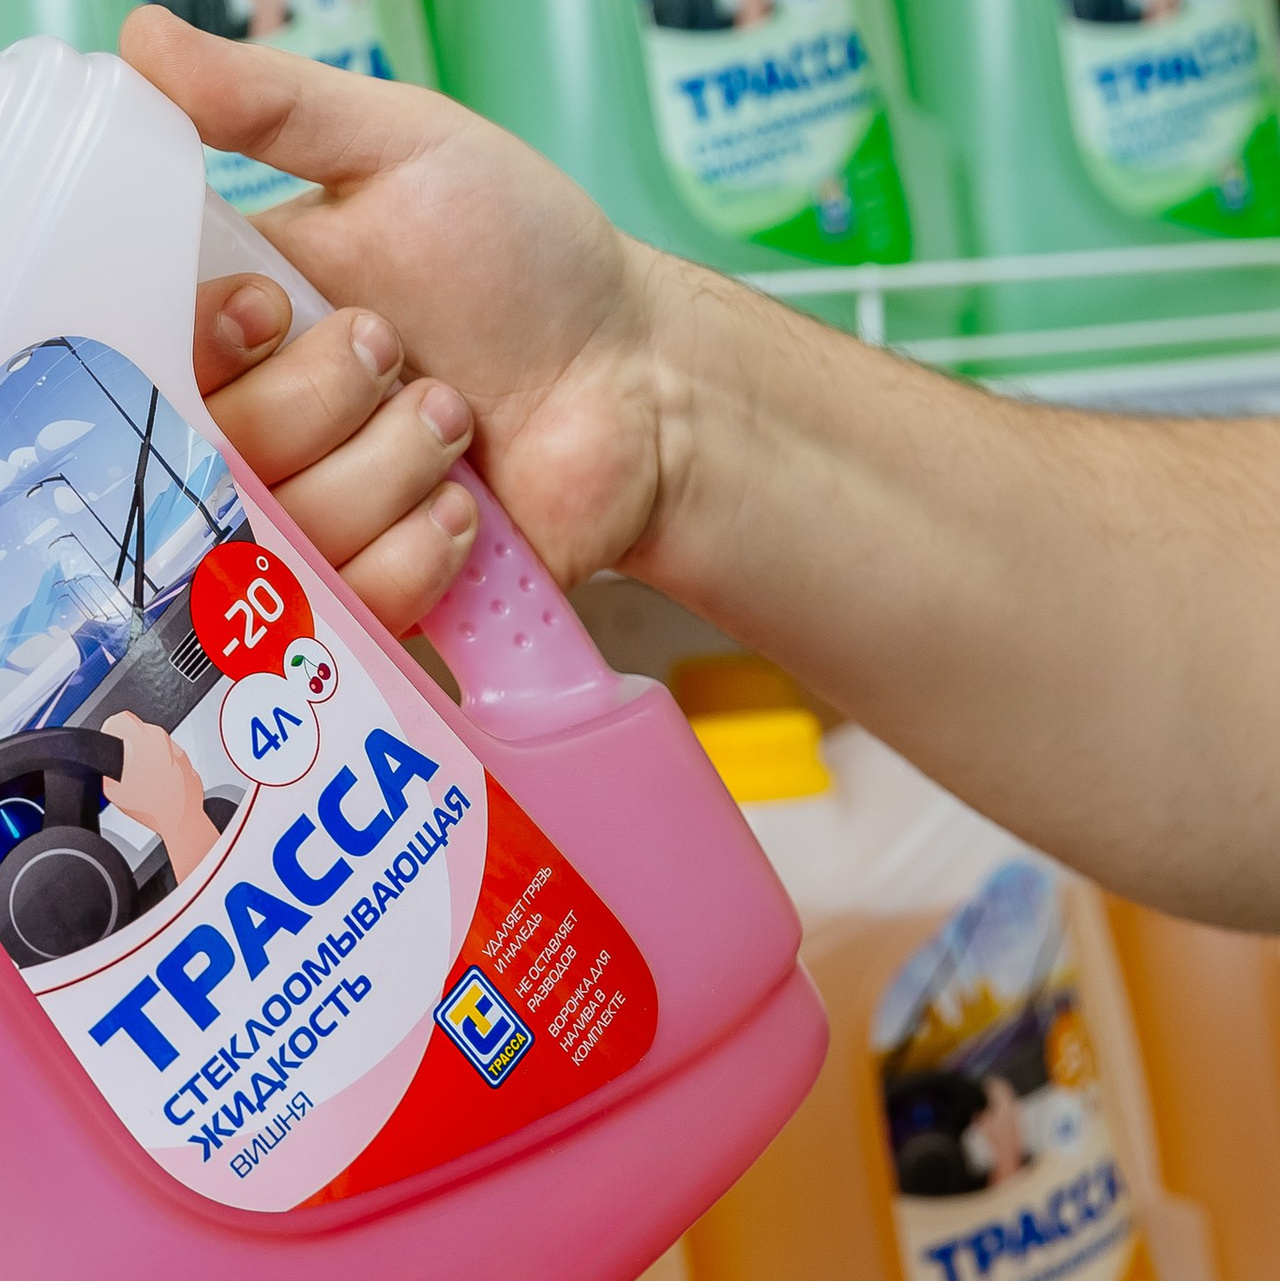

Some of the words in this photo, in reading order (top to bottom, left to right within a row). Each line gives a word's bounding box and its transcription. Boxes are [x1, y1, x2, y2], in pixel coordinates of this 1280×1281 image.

[87, 728, 440, 1076] ТРАССА
[482, 898, 527, 958] УДАЛЯЕТ
[522, 865, 553, 906] ГРЯЗЬ
[504, 911, 543, 964] НАЛЕДЬ
[162, 784, 472, 1127] СТЕКЛООМЫВАЮЩАЯ
[514, 978, 534, 999] НЕ
[528, 909, 578, 981] ОСТАВЛЯЕТ
[526, 944, 578, 1014] РАЗВОДОВ
[547, 977, 593, 1038] ВОРОНКА
[588, 949, 612, 984] ДЛЯ
[187, 973, 373, 1164] ЖИДКОСТЬ
[487, 1032, 528, 1077] ТРАССА
[559, 1003, 598, 1053] НАЛИВА
[571, 990, 627, 1067] КОМПЛЕКТЕ
[230, 1090, 314, 1180] ВИШНЯ
